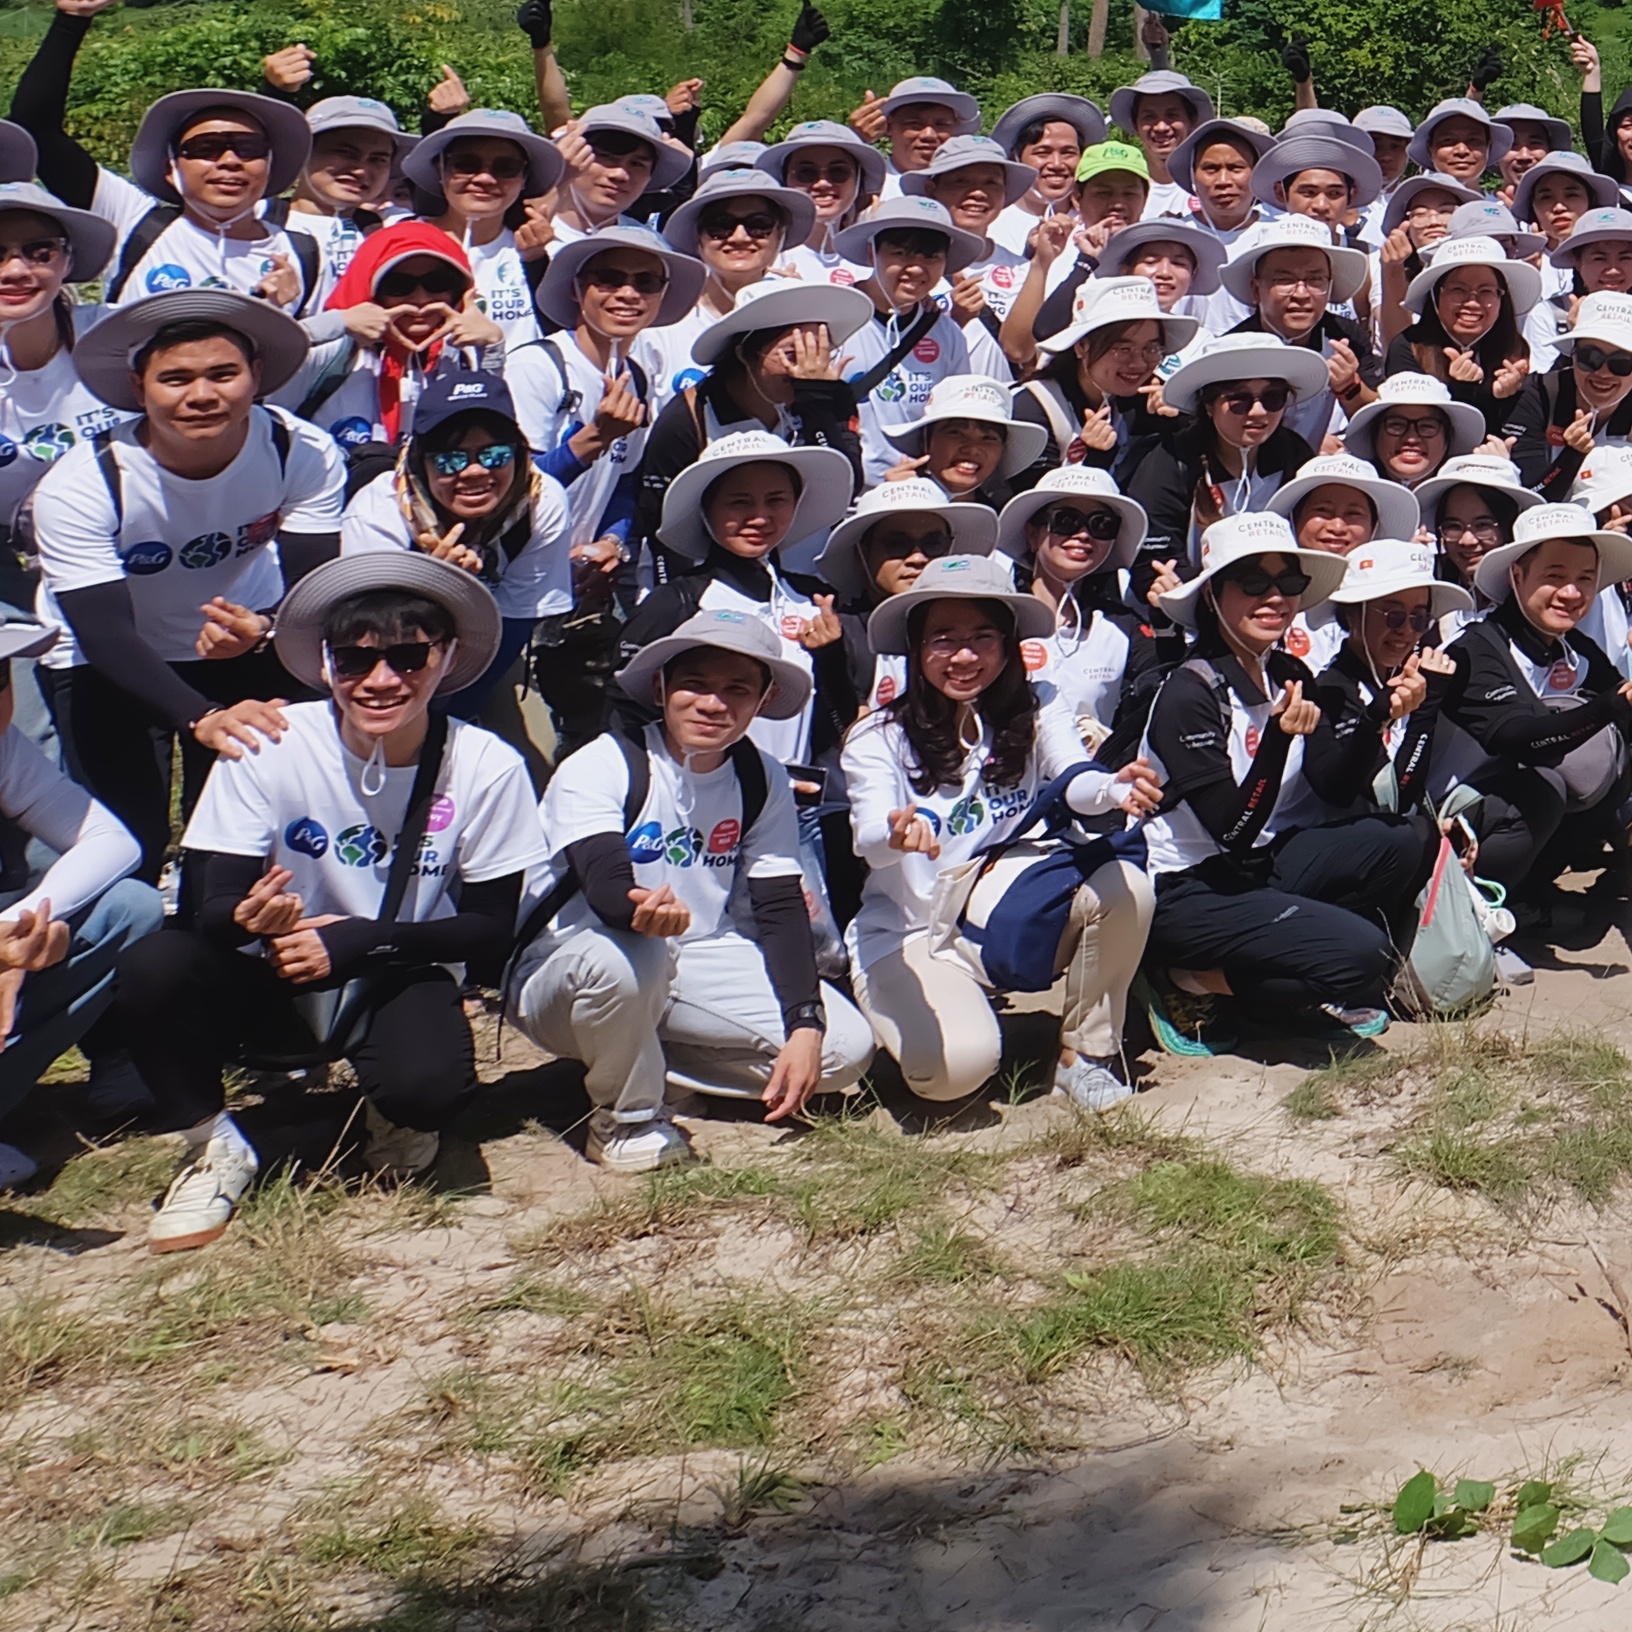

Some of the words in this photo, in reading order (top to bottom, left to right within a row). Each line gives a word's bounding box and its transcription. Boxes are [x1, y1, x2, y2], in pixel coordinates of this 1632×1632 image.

[490, 289, 519, 299] IT'S
[492, 300, 523, 310] OUR
[908, 372, 931, 382] IT'S
[453, 383, 483, 395] P&G
[75, 408, 114, 426] IT'S
[881, 484, 932, 499] CENTRAL
[129, 551, 167, 565] P&G
[1530, 734, 1569, 749] CENTRAL
[1405, 733, 1427, 774] CENTRAL
[991, 790, 1029, 809] OUR
[1222, 811, 1252, 842] CENTRAL
[702, 855, 738, 867] HOM
